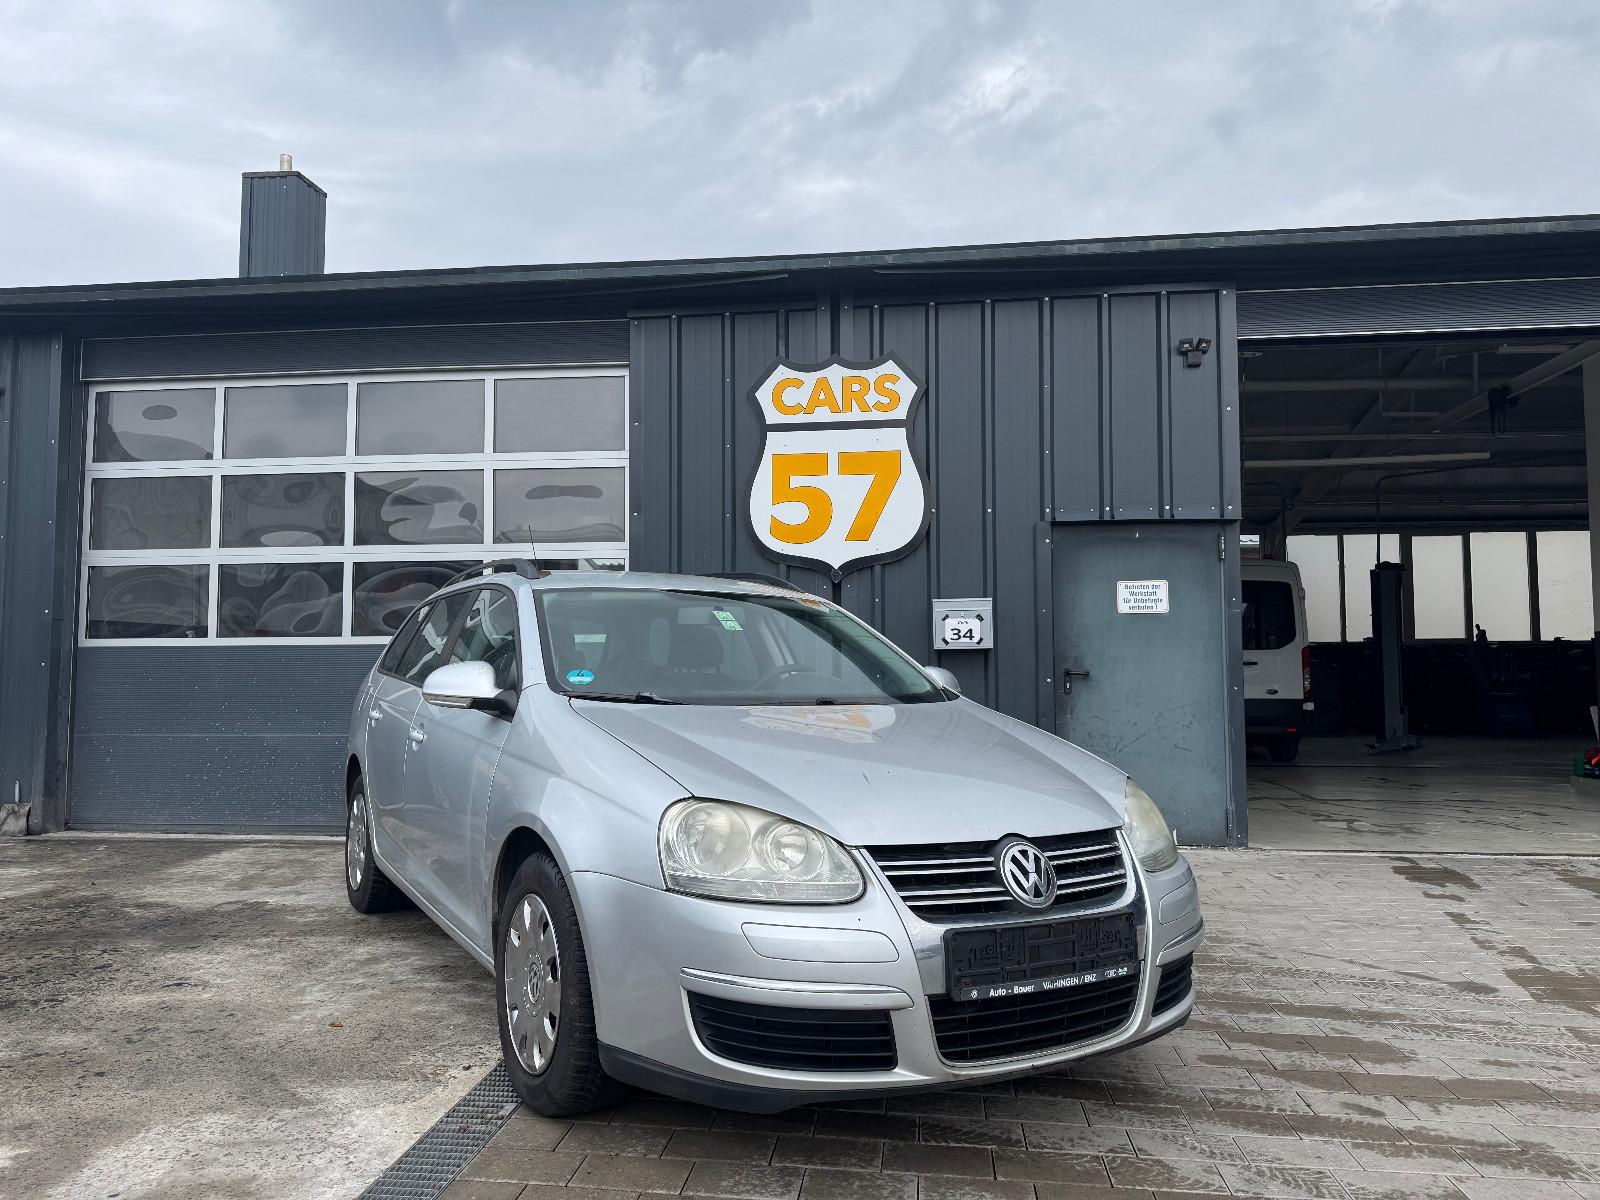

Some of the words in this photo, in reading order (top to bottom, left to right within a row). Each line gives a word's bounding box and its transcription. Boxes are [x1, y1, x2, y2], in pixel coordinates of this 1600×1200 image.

[771, 373, 901, 416] CARS
[769, 449, 902, 545] 57
[949, 627, 975, 641] 34
[989, 987, 1006, 997] Auto
[1013, 984, 1035, 994] Bauer
[1084, 973, 1097, 983] ENZ
